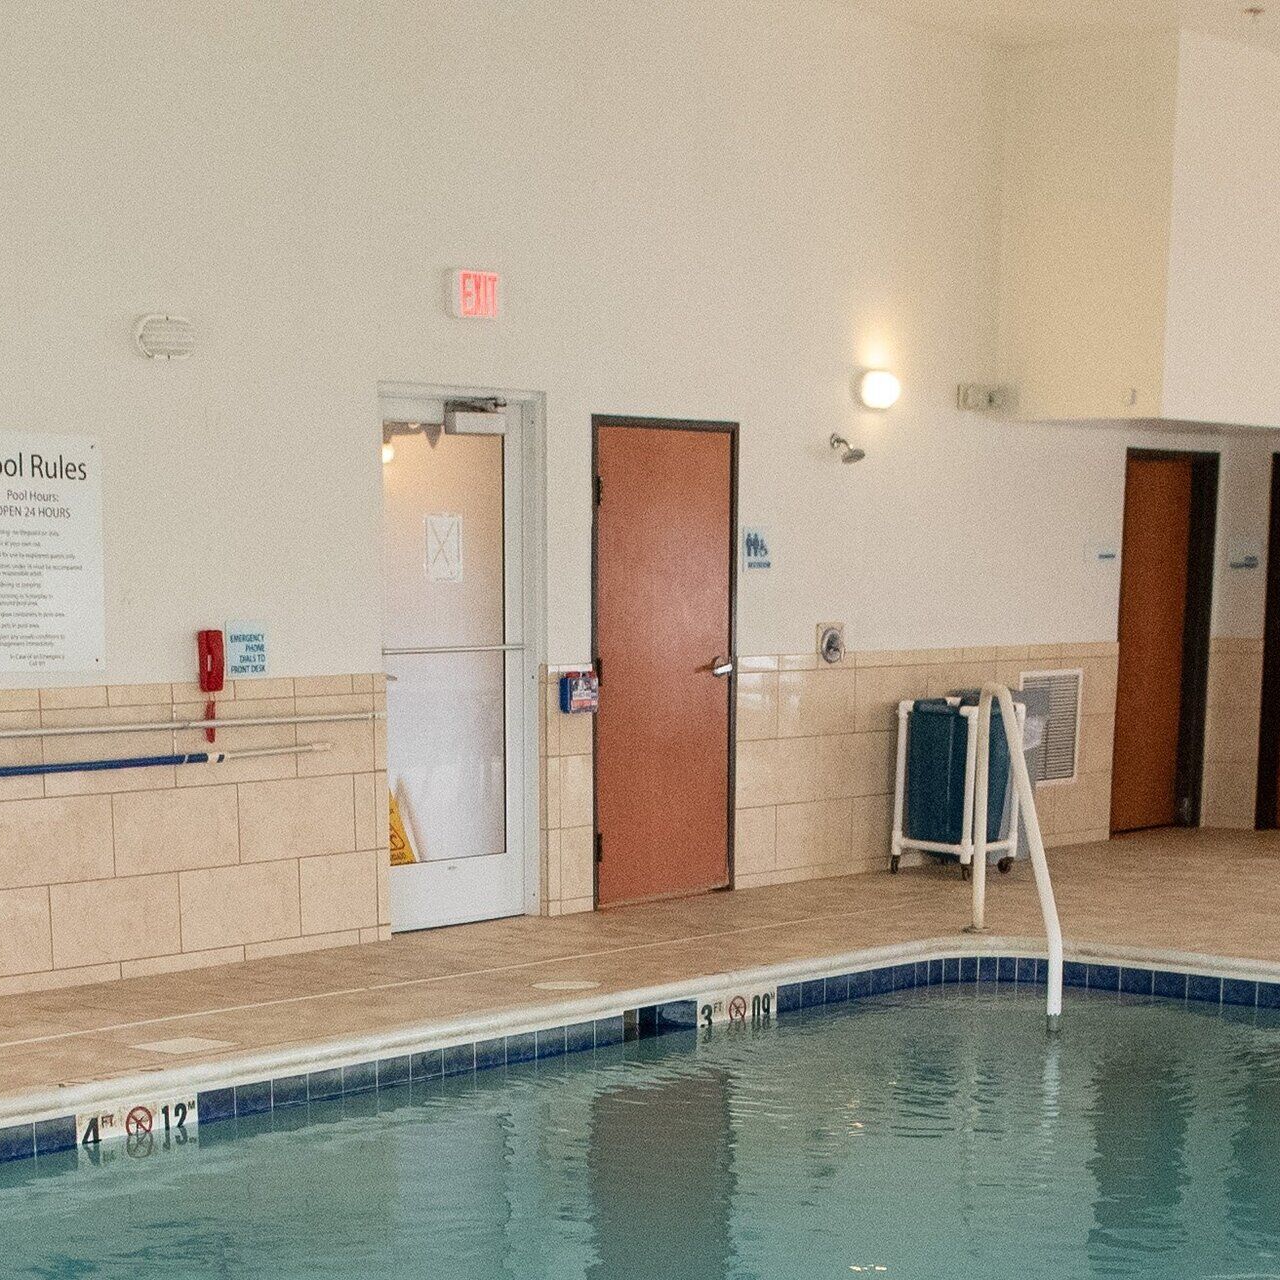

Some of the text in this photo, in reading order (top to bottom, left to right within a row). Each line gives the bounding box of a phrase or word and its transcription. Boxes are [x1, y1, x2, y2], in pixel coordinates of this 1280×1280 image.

[462, 273, 498, 316] EXIT
[31, 454, 87, 481] Rules
[7, 489, 59, 503] Pool Hours:
[24, 507, 35, 517] 24
[38, 507, 71, 519] HOURS
[230, 633, 264, 643] EMERGENCY
[245, 644, 265, 652] PHONE
[239, 654, 265, 663] DIALS TO
[231, 664, 266, 674] FRONT DESK
[701, 1004, 713, 1028] 3
[714, 1002, 722, 1013] FT
[82, 1117, 102, 1144] 4
[101, 1114, 114, 1127] FT
[188, 1100, 195, 1110] M
